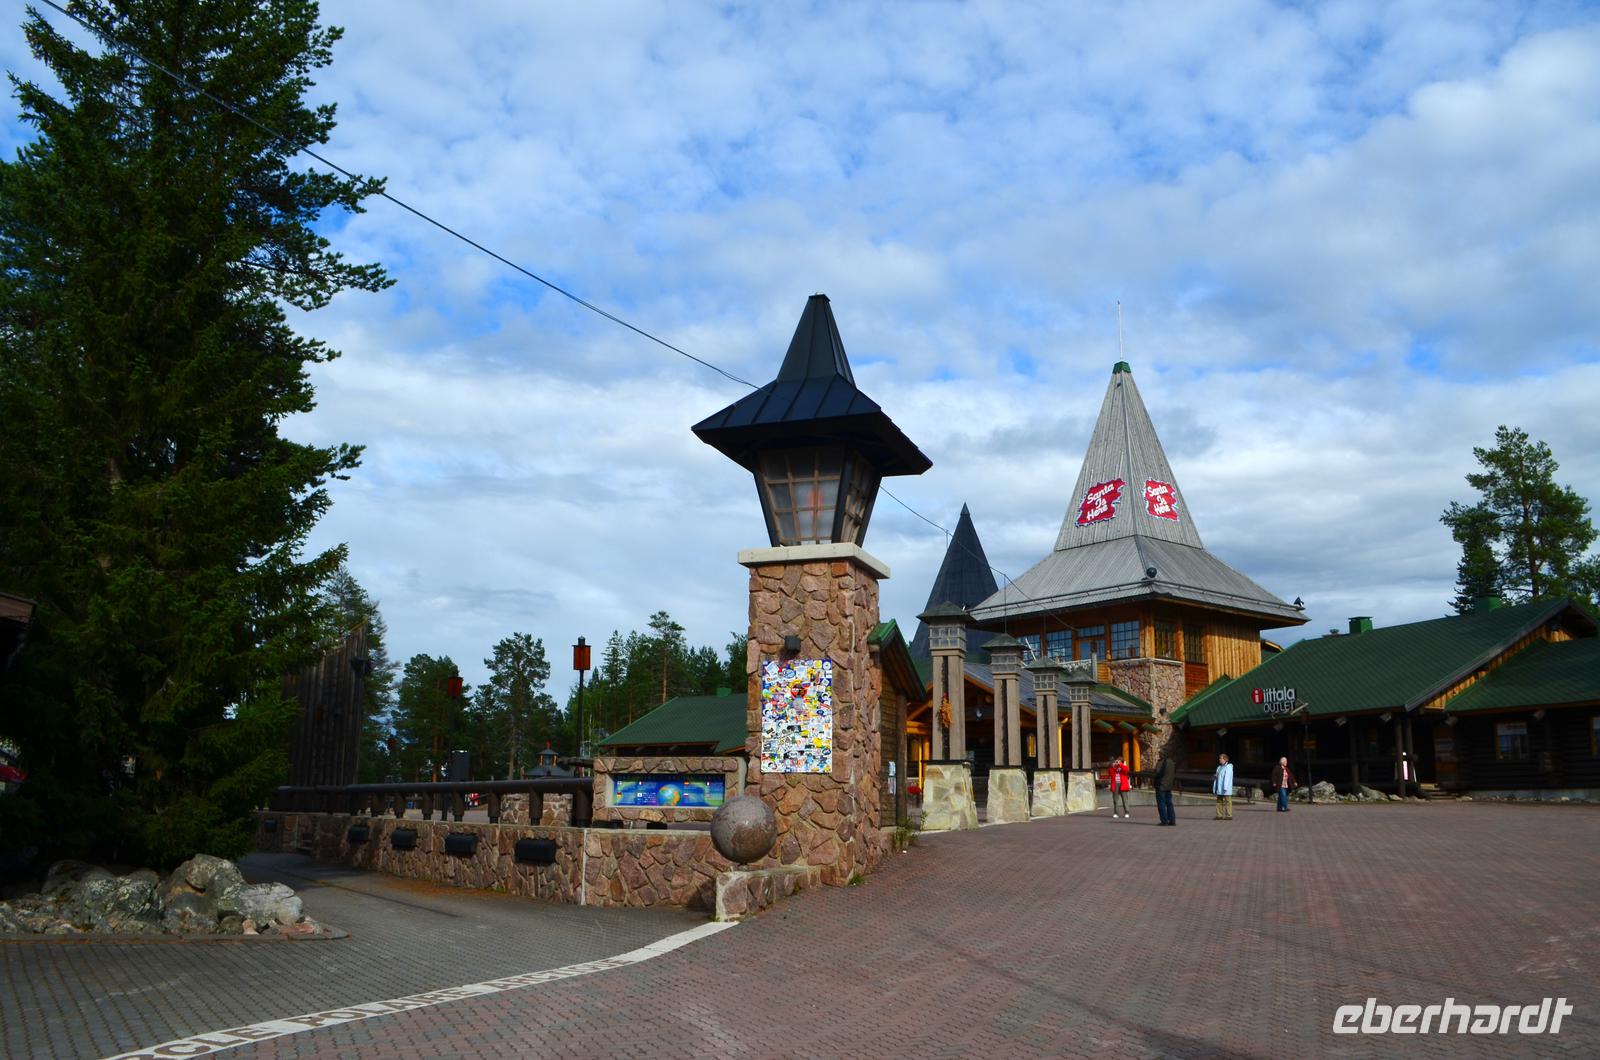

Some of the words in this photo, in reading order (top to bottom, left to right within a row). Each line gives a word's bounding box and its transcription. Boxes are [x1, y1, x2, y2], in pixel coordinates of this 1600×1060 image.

[1087, 484, 1114, 504] Santa
[1147, 485, 1168, 497] Santa
[1086, 504, 1108, 520] Here
[1153, 503, 1170, 514] Here
[1263, 686, 1296, 703] iittala
[1263, 700, 1295, 713] OUTLET
[285, 989, 481, 1027] POLAIRE
[483, 960, 637, 989] ARCTIQUE
